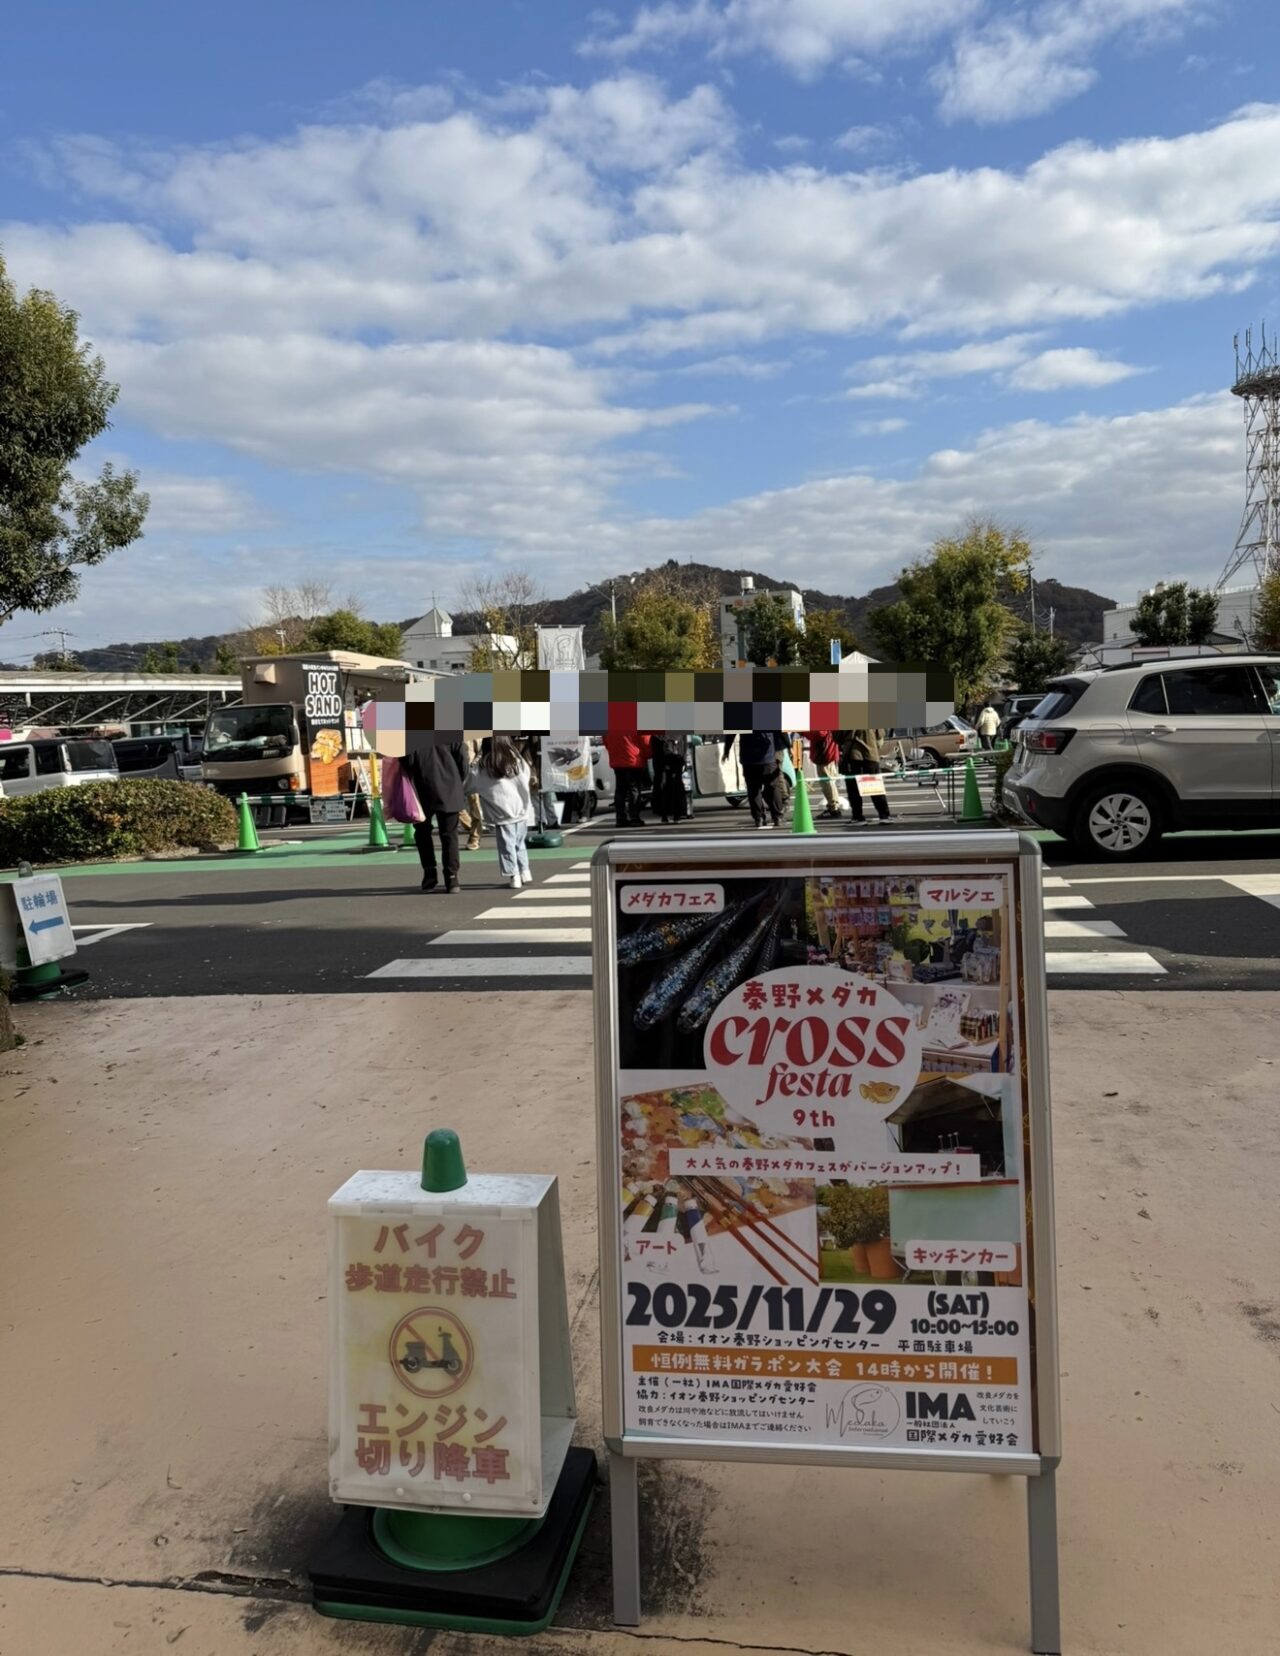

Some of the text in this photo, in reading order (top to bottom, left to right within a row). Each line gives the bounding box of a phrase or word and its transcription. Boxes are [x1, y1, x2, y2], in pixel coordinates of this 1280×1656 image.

[308, 671, 337, 695] HOT
[305, 694, 342, 718] SAND
[21, 890, 58, 911] 駐輪場
[627, 891, 718, 908] メダカフェス
[927, 888, 995, 903] マルシェ
[742, 982, 877, 1010] 秦野メダカ
[709, 1015, 911, 1068] cross
[755, 1062, 853, 1106] festa
[793, 1109, 835, 1128] 9th
[686, 1156, 961, 1175] 大人気の秦野メダカフェスがバージョンアップ！
[374, 1223, 485, 1260] バイク
[636, 1240, 677, 1255] アート
[913, 1248, 1009, 1265] キッチンカー
[345, 1262, 517, 1299] 歩道走行禁止
[625, 1281, 897, 1335] 2025/11/29
[927, 1290, 990, 1318] (SAT)
[898, 1339, 973, 1354] 平面駐車場
[650, 1352, 842, 1377] 恒例無料ガラポン大会
[905, 1391, 976, 1421] IMA
[976, 1391, 1020, 1400] 改良メダカを
[979, 1404, 1018, 1413] 文化芸術に
[357, 1403, 508, 1443] エンジン
[906, 1420, 956, 1429] 一般社団法人
[982, 1417, 1015, 1426] していこう
[906, 1429, 1019, 1446] 国際メダカ愛好会
[355, 1437, 511, 1484] 切り降車
